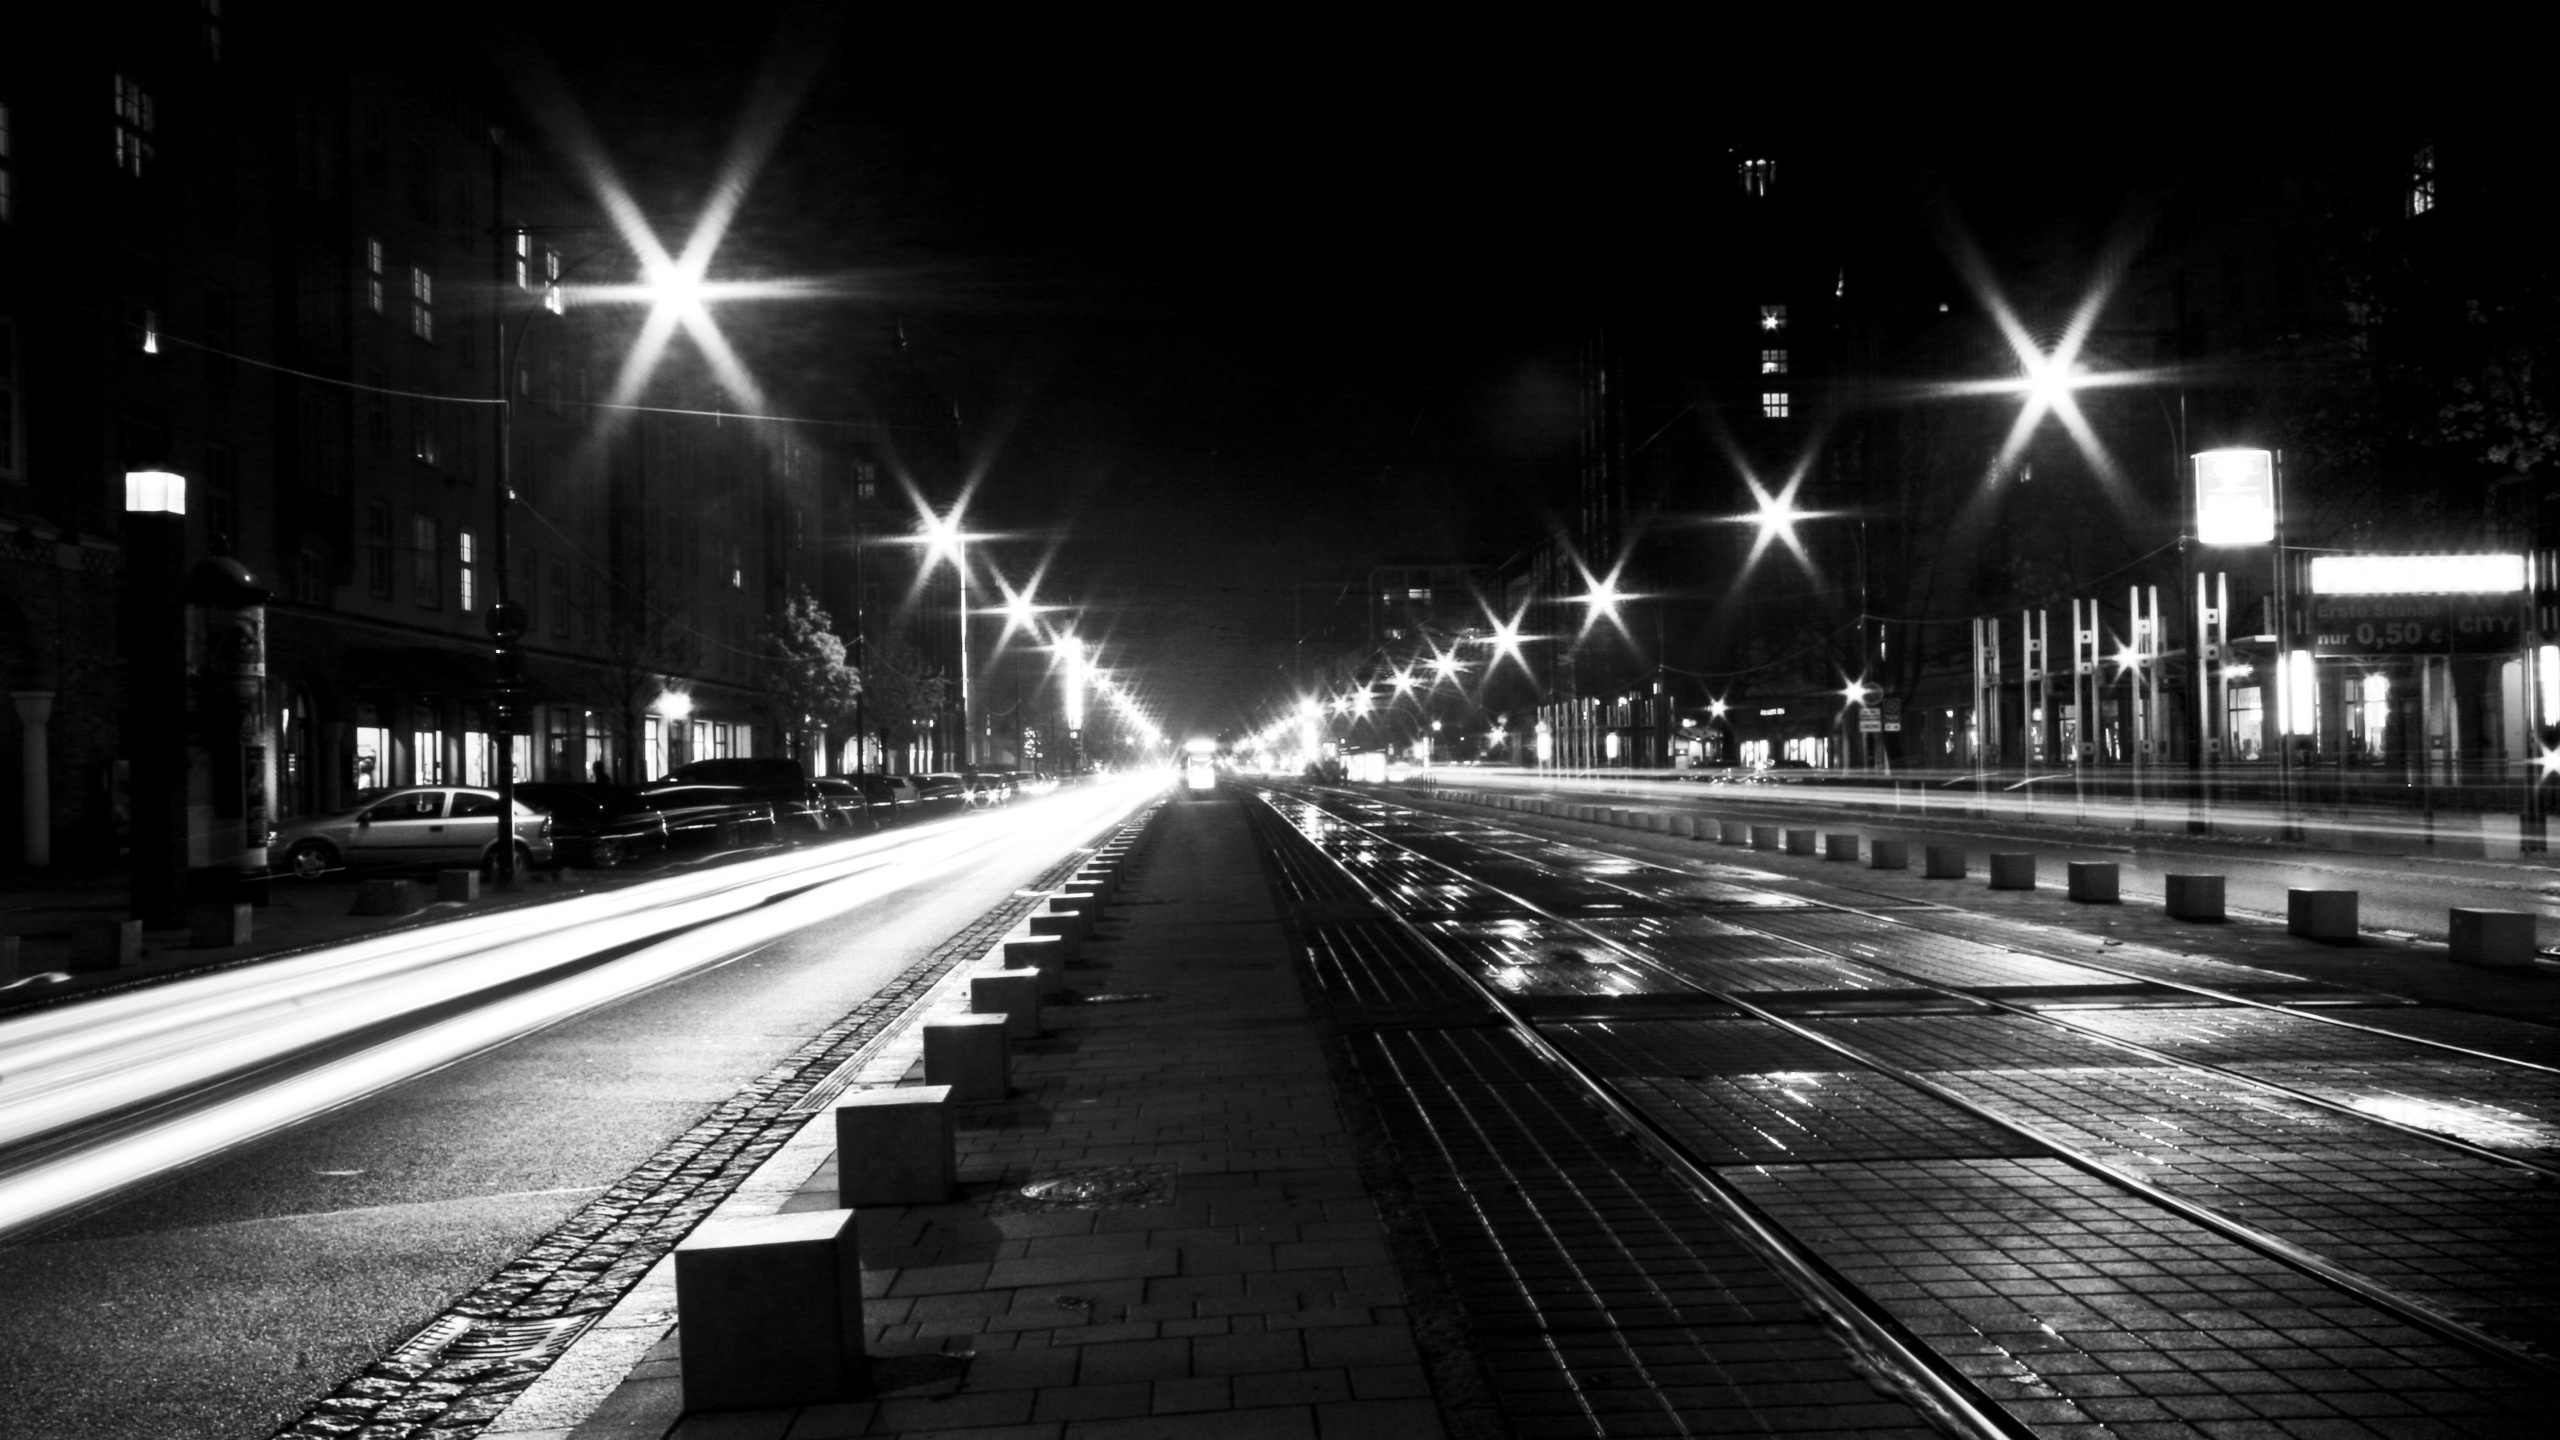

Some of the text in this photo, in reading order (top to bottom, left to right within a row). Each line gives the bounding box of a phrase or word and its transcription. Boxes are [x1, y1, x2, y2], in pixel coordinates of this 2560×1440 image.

[2317, 604, 2368, 618] Erste
[2460, 614, 2514, 633] CITY
[2317, 633, 2350, 645] nur
[2356, 622, 2422, 648] 0,50
